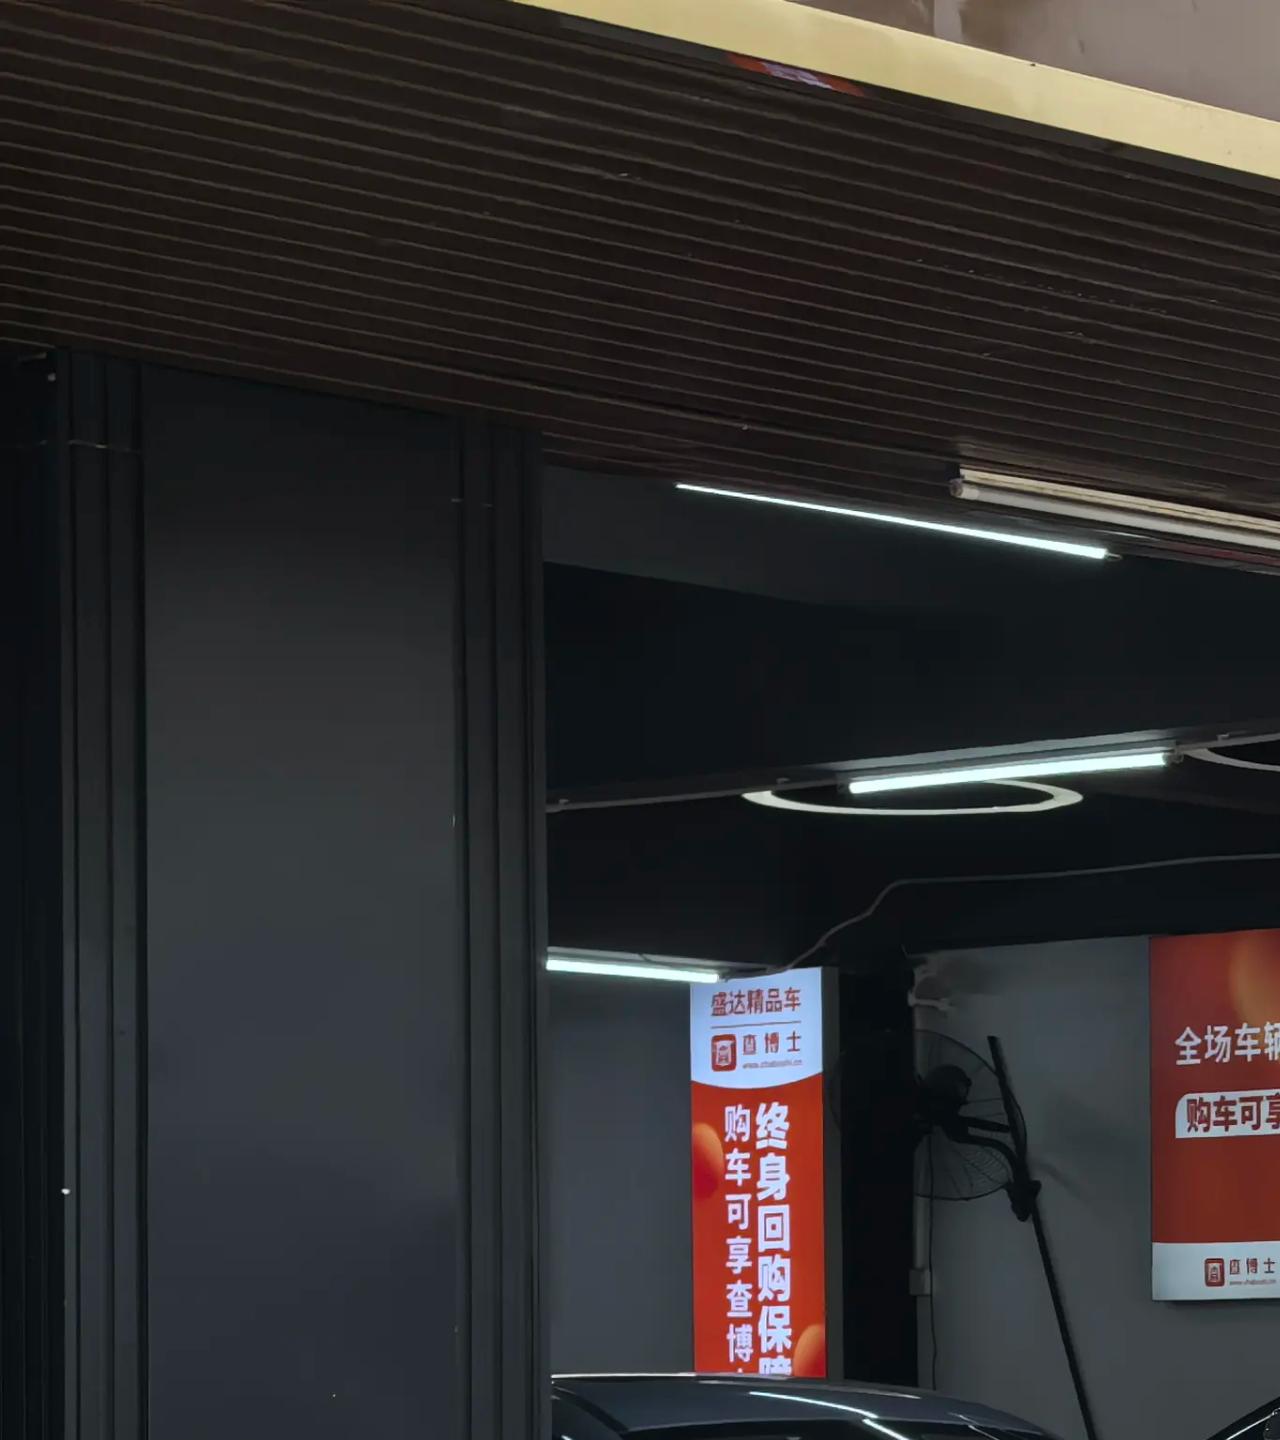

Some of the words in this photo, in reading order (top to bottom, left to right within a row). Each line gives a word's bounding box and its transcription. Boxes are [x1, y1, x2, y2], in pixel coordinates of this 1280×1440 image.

[711, 986, 801, 1016] 盛达精品车
[723, 1104, 754, 1374] 购车可享查博
